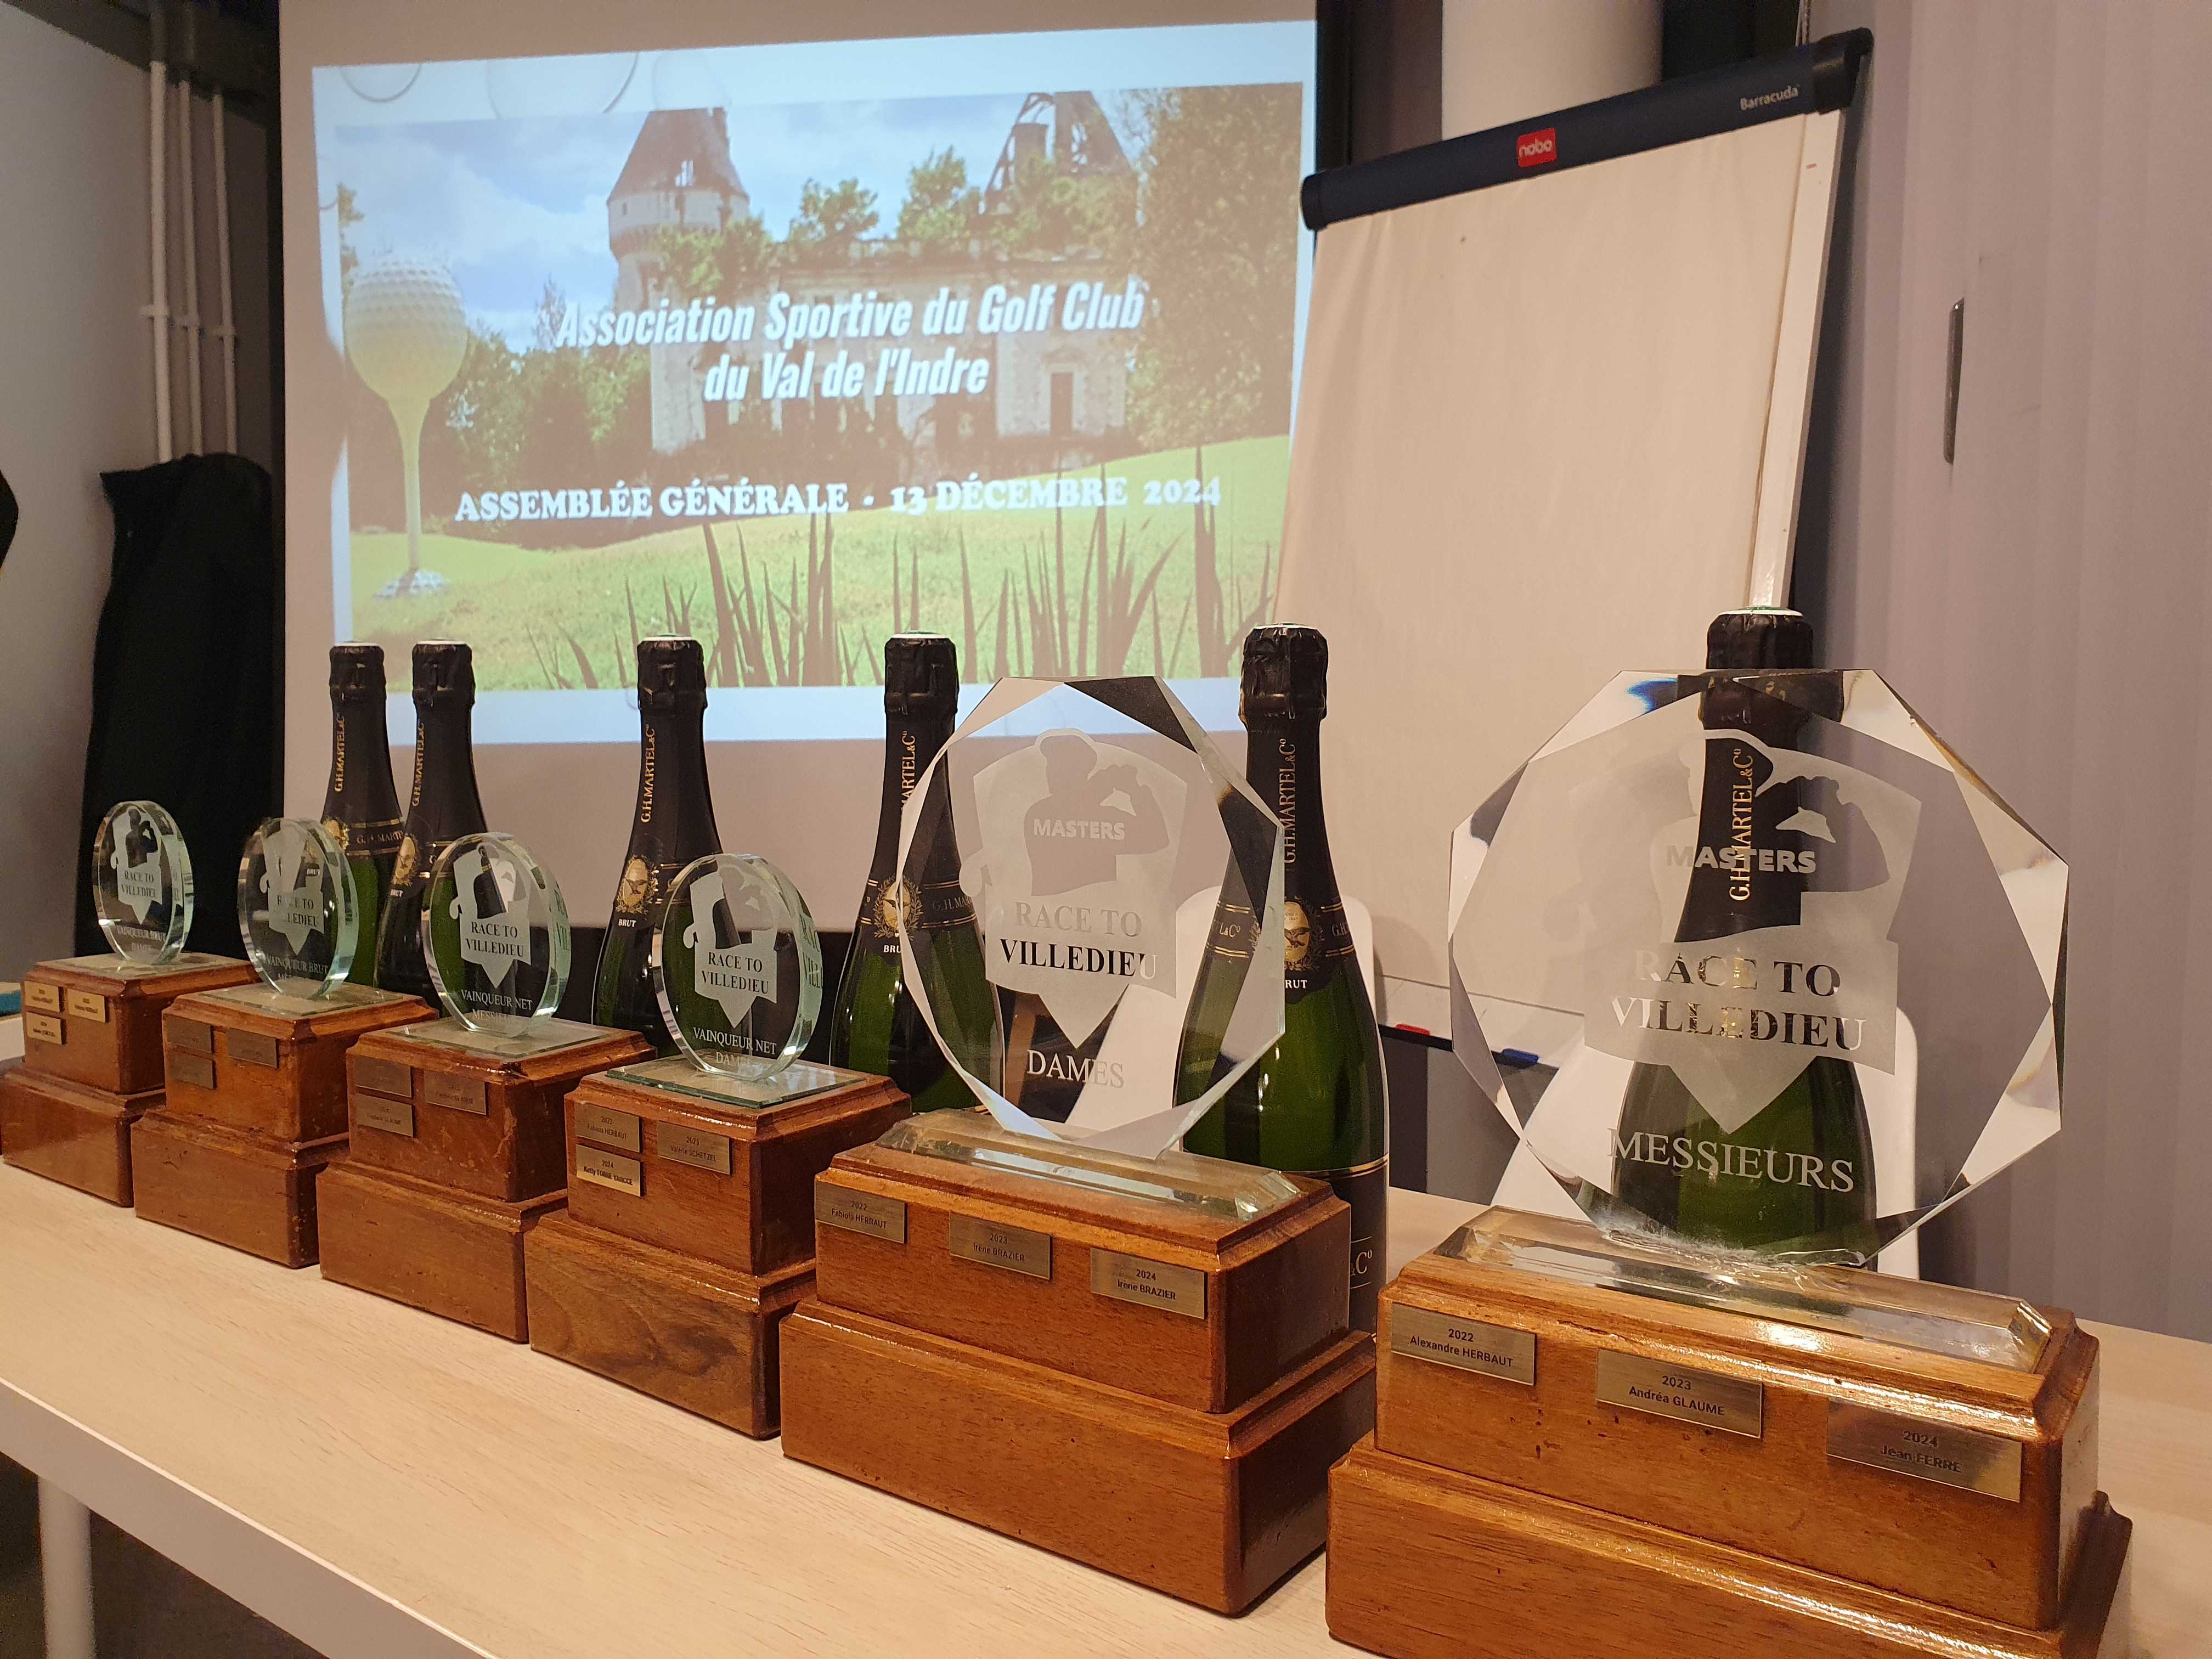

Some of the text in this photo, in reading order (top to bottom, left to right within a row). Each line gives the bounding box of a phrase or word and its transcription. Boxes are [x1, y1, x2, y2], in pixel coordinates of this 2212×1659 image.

[1740, 85, 1798, 110] Barracuda
[1519, 138, 1553, 157] nobo
[555, 276, 1146, 350] Association Sportive du Golf Club
[704, 346, 989, 402] du Val de l'Indre
[455, 479, 653, 522] ASSEMBLÉE
[659, 477, 849, 517] GÉNÉRALE
[890, 487, 928, 516] 13
[935, 472, 1128, 511] DÉCEMBRE
[1143, 477, 1221, 506] 2024
[1034, 819, 1125, 840] MASTERS
[1666, 845, 1816, 873] MASTERS
[302, 898, 314, 910] TO
[471, 921, 518, 939] RACE TO
[618, 918, 636, 927] BRUT
[1015, 901, 1142, 938] RACE TO
[465, 938, 524, 957] VILLEDIEU
[883, 945, 901, 953] BRU
[708, 952, 763, 973] RACE TO
[1000, 939, 1157, 980] VILLEDIEU
[702, 970, 769, 994] VILLEDIEU
[1285, 979, 1308, 989] RUT
[1634, 950, 1841, 997] RACE TO
[461, 989, 533, 1011] VAINQUEUR NET
[1611, 996, 1867, 1051] VILLEDIEU
[693, 1026, 777, 1054] VAINQUEUR NET
[1027, 1049, 1124, 1089] DAMES
[1607, 1127, 1854, 1193] MESSIEURS
[851, 1200, 867, 1211] 2022
[855, 1214, 887, 1229] HERBAUT
[990, 1233, 1008, 1244] 2023
[992, 1247, 1025, 1262] BRAZIER
[1136, 1268, 1156, 1281] 2024
[1139, 1284, 1176, 1300] BRAZIER
[1448, 1328, 1474, 1342] 2022
[1410, 1335, 1514, 1367] Alexandre HERBAUT
[1662, 1375, 1691, 1391] 2023
[1628, 1385, 1725, 1416] Andréa GLAUME
[1902, 1430, 1939, 1448] 2024
[1880, 1444, 1962, 1474] Jean FERRE
